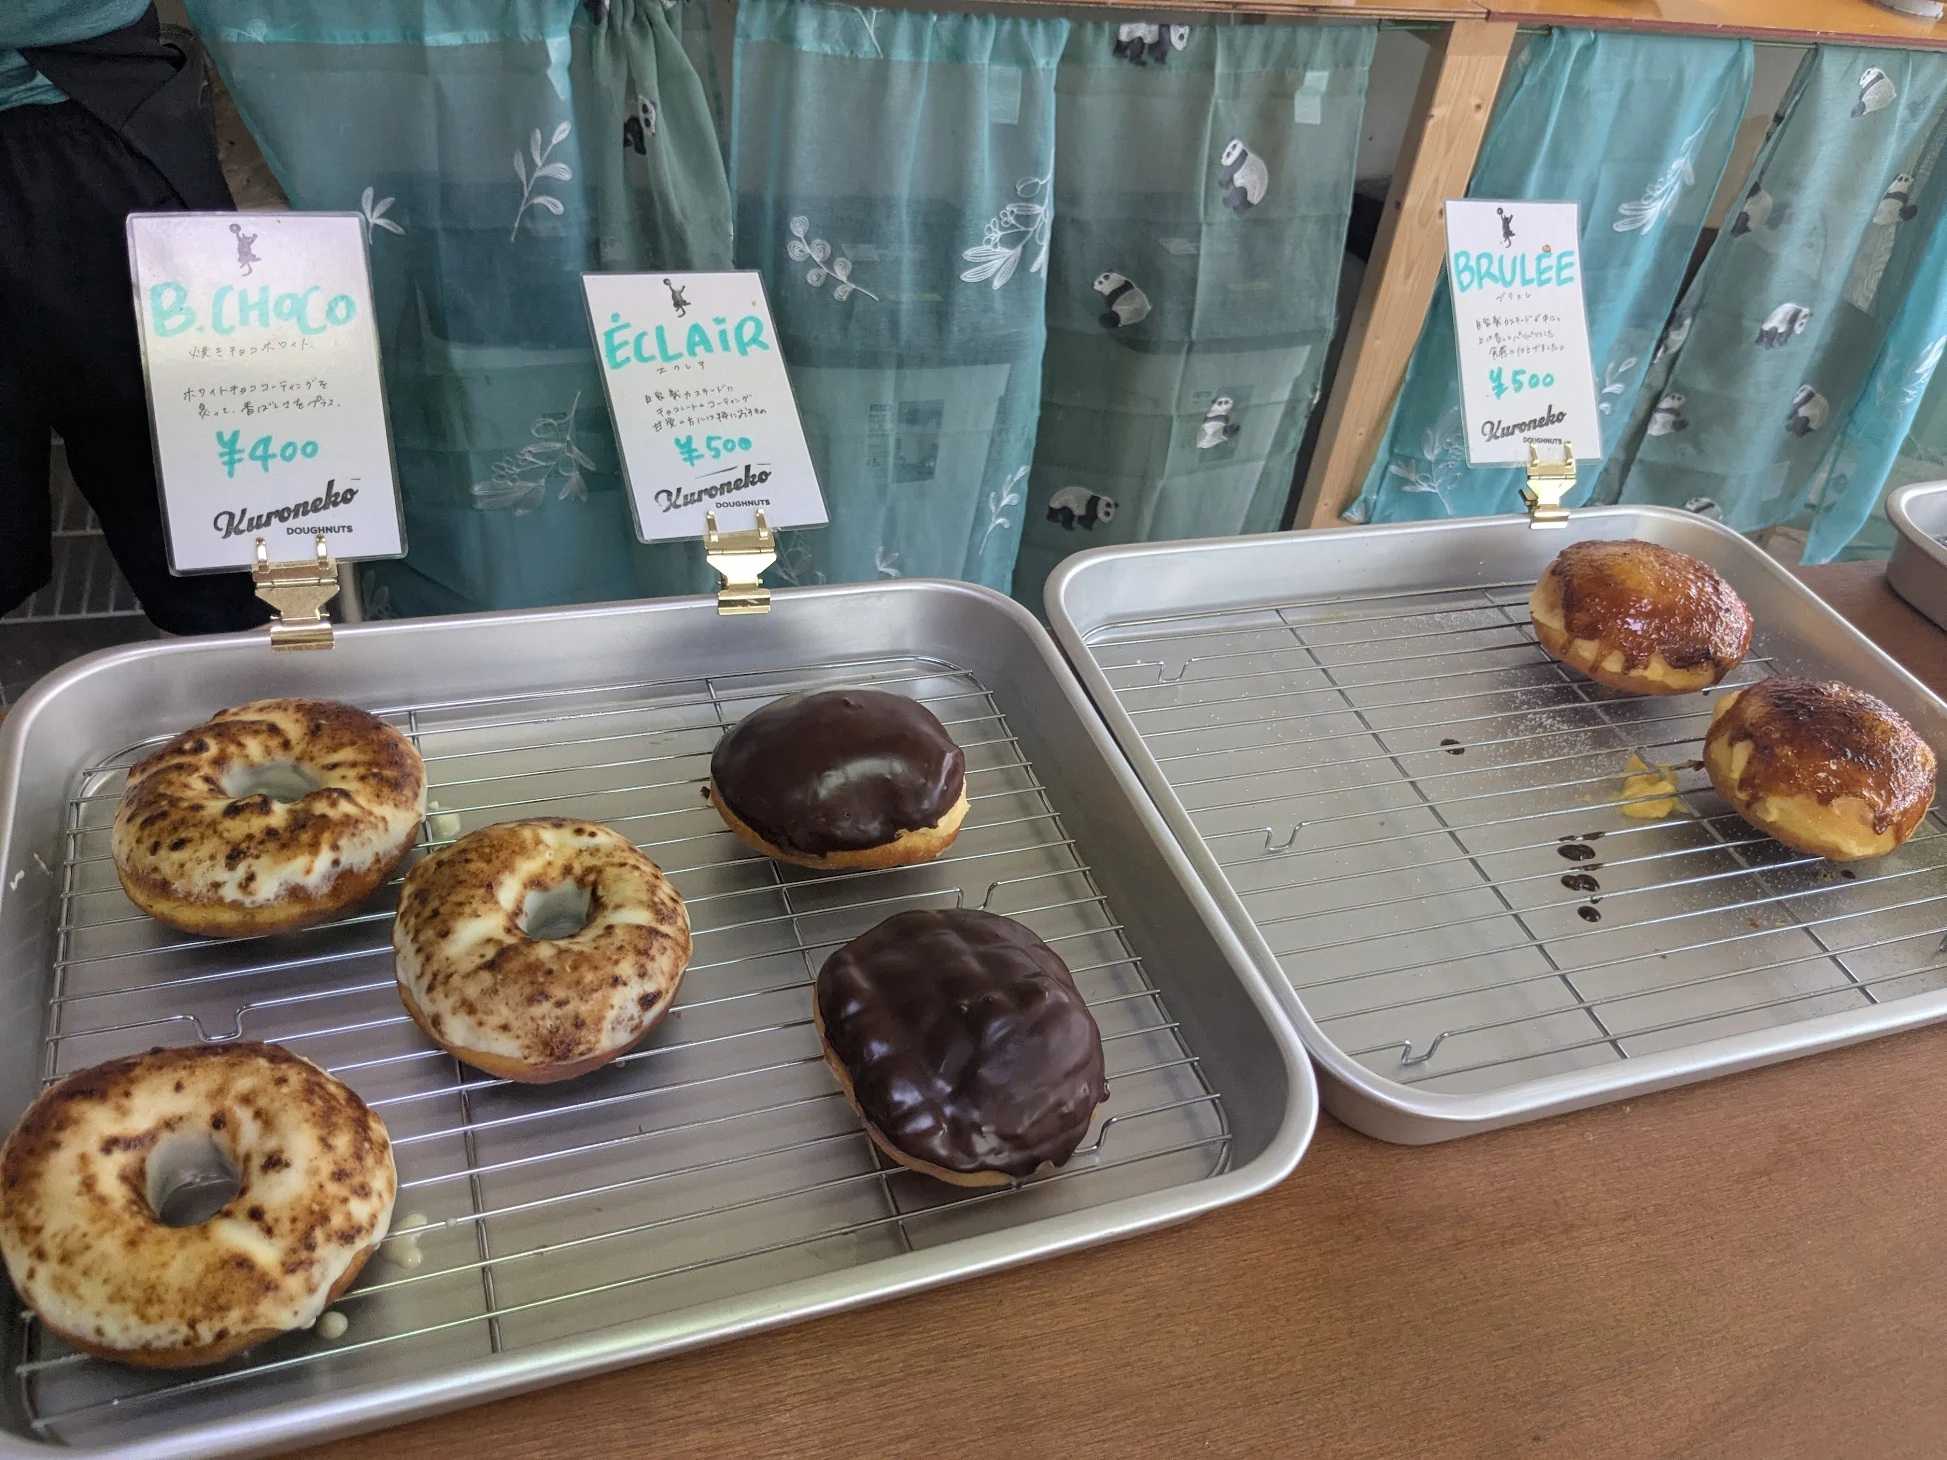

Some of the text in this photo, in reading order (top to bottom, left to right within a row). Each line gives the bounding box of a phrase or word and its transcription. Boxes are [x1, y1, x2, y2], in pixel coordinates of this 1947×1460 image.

[1488, 366, 1555, 400] ¥500
[1481, 405, 1567, 442] Kuroneko
[215, 430, 319, 478] ¥400
[674, 435, 752, 467] ¥500
[654, 464, 772, 512] Kuroneko
[715, 498, 771, 509] DOUGHNUTS
[213, 480, 358, 539] Kuroneko
[286, 525, 353, 536] DOUGHNUTS
